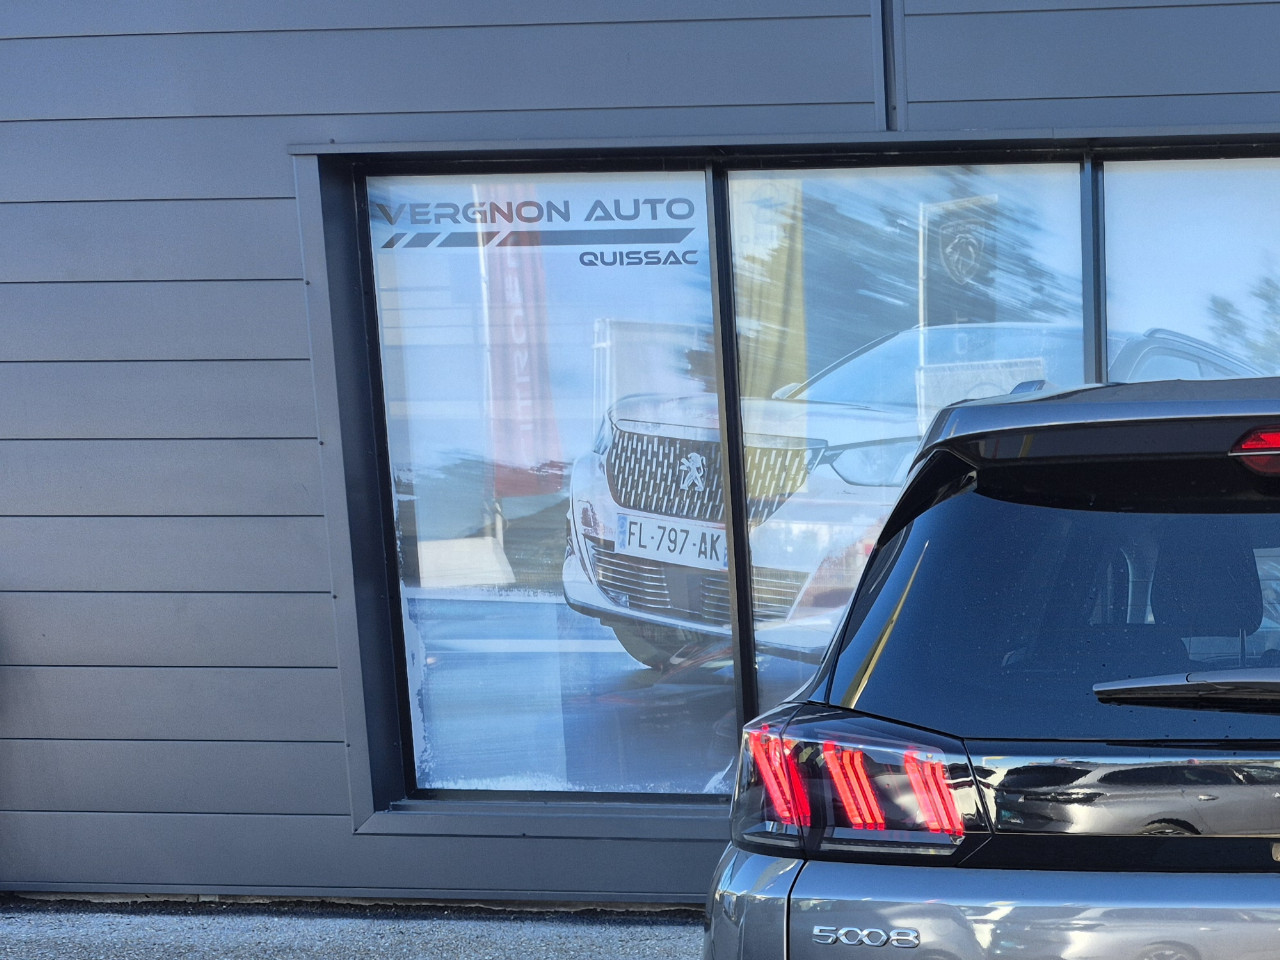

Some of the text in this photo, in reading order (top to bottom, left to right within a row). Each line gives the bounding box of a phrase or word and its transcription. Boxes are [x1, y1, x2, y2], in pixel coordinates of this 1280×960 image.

[376, 197, 695, 226] VERGNON AUTO
[579, 249, 699, 267] QUISSAC
[628, 521, 721, 561] FL-797-AK
[812, 925, 920, 949] 5008
